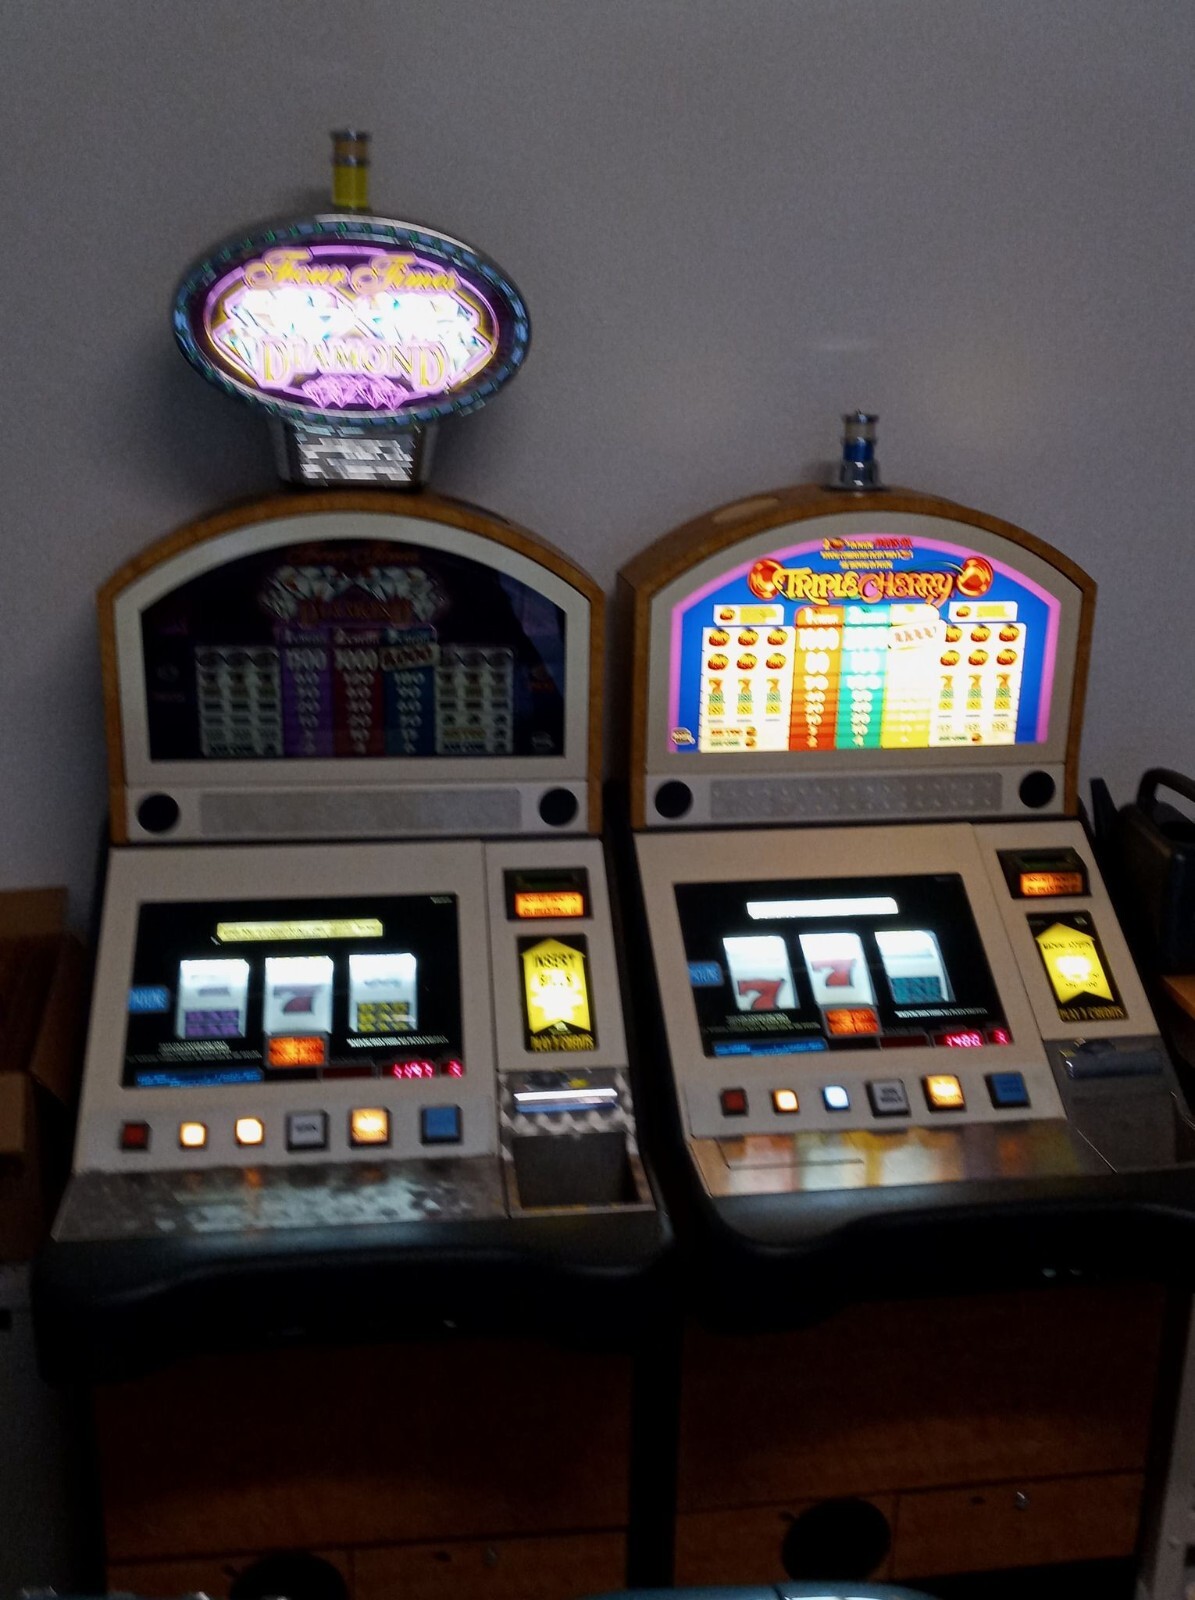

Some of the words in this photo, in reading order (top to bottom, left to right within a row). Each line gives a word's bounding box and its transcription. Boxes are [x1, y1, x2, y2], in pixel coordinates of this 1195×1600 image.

[256, 338, 448, 389] DIAMOND
[772, 567, 862, 606] TRIPLE
[858, 570, 955, 609] CHERRY
[737, 978, 786, 1012] 7
